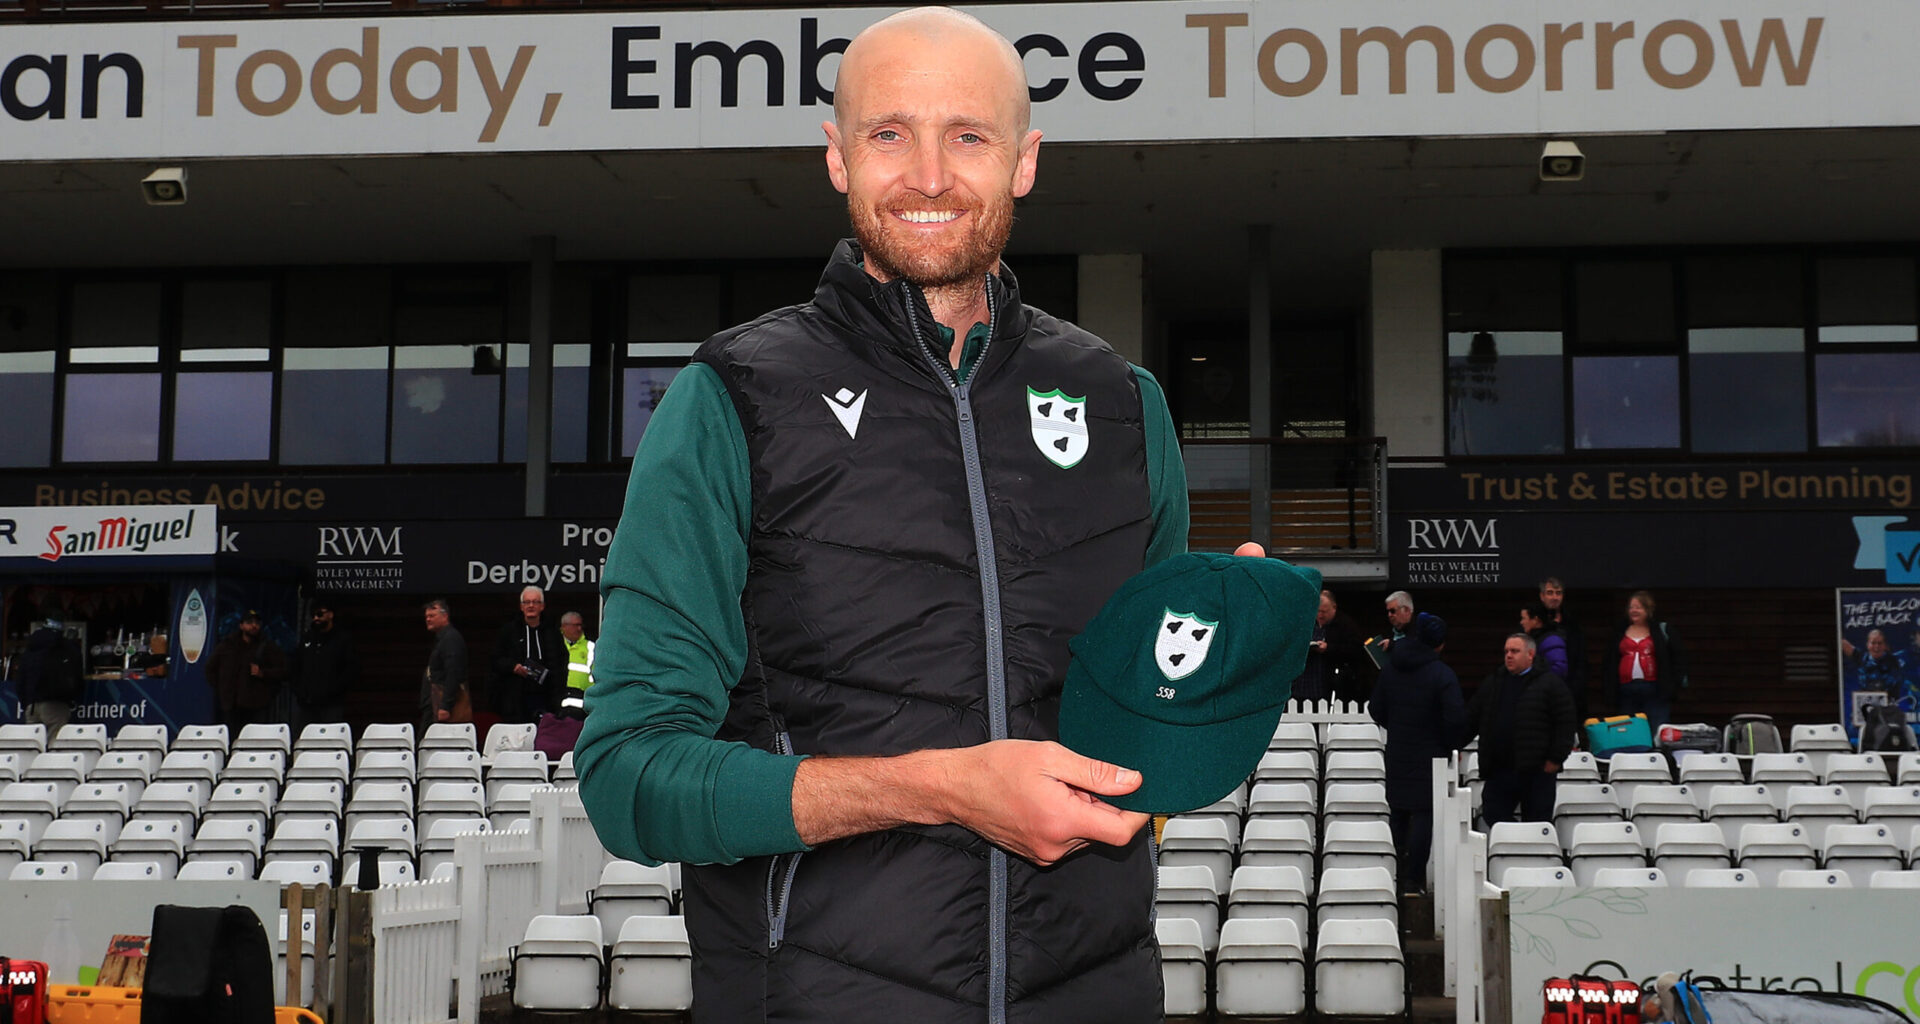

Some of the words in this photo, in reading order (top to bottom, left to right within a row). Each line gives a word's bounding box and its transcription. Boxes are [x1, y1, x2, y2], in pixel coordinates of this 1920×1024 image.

[177, 26, 563, 143] Today,
[610, 18, 1146, 110] Embce
[1185, 13, 1825, 98] Tomorrow
[35, 481, 193, 505] Business
[204, 480, 325, 510] Advice
[1461, 472, 1558, 500] Trust
[1568, 472, 1598, 500] &
[1608, 471, 1728, 500] Estate
[1739, 467, 1912, 507] Planning
[317, 526, 403, 556] RWM
[563, 523, 616, 546] Pro
[1408, 518, 1500, 549] RWM
[317, 568, 351, 577] RYLEY
[354, 568, 402, 577] WEALTH
[1408, 562, 1445, 571] RYLEY
[1448, 562, 1499, 571] WEALTH
[317, 580, 402, 589] MANAGEMENT
[1408, 574, 1500, 583] MANAGEMENT
[1843, 602, 1869, 616] THE
[1870, 598, 1920, 614] FALCO
[1846, 615, 1873, 629] ARE
[1875, 612, 1912, 626] BACK
[1156, 686, 1176, 700] 558
[69, 701, 126, 719] artner
[130, 699, 147, 718] of
